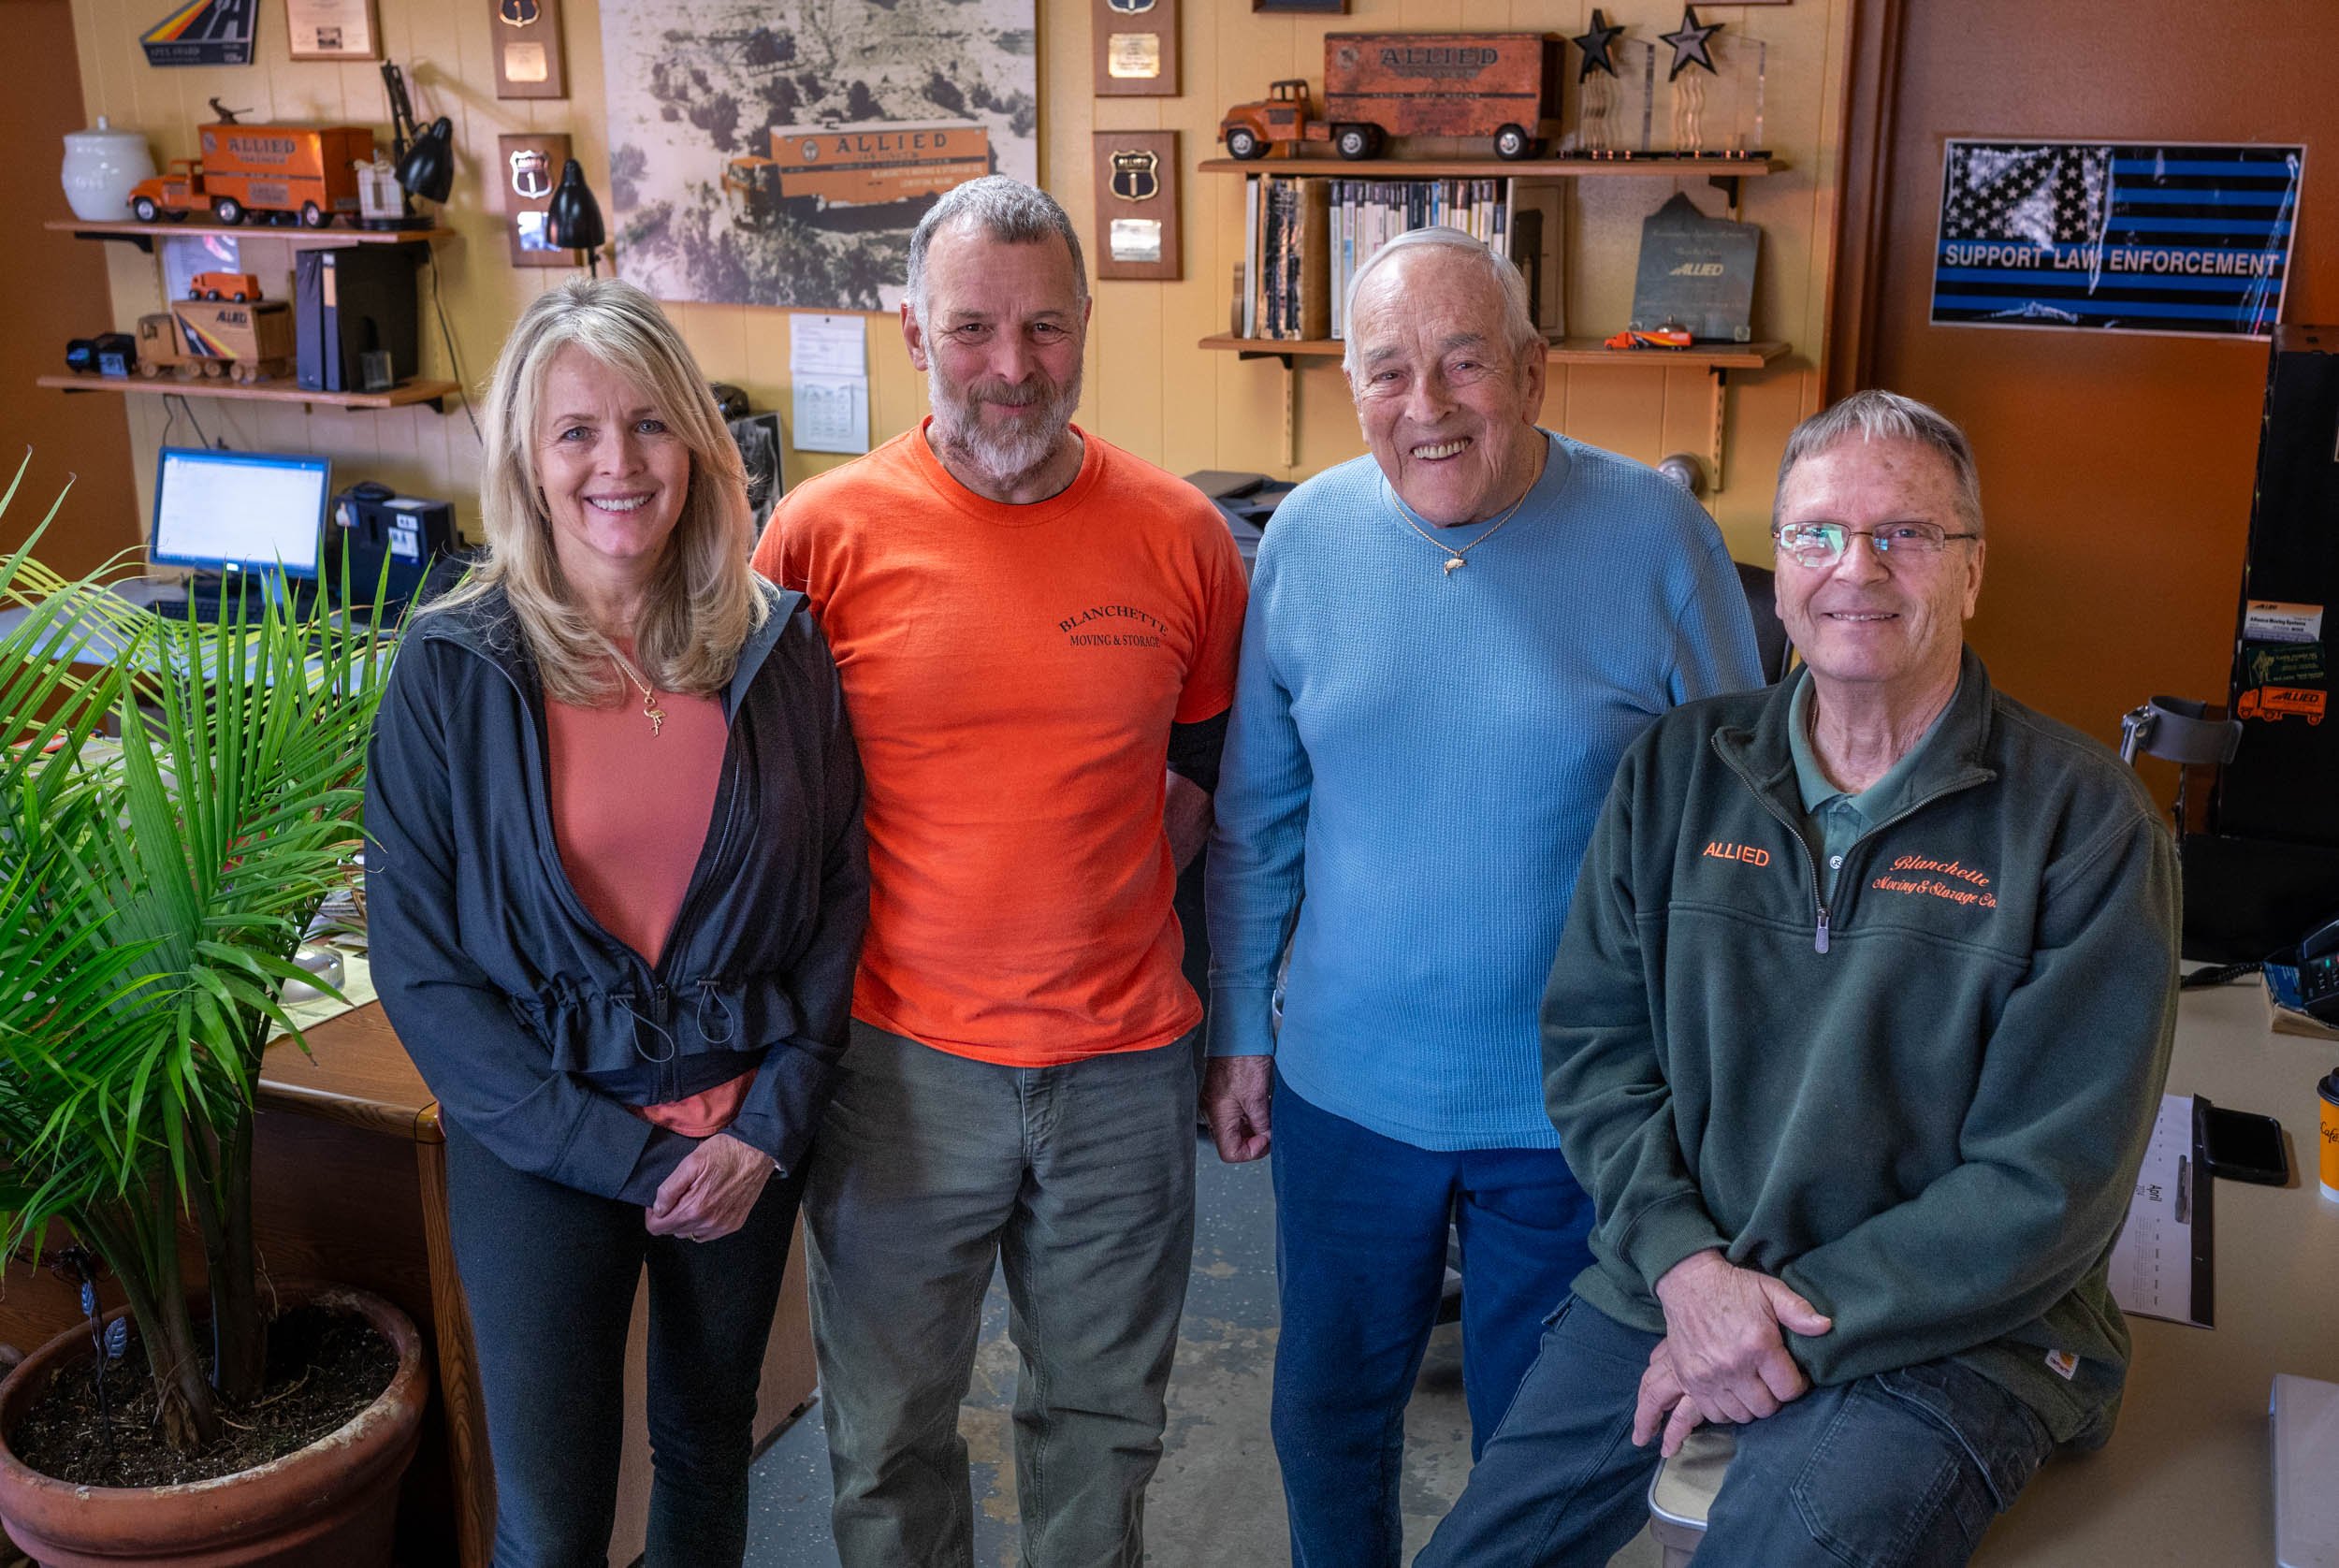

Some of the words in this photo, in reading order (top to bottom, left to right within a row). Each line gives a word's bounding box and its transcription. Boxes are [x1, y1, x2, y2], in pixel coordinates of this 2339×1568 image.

[1380, 47, 1499, 65] ALLIED
[228, 138, 297, 154] ALLIED
[835, 133, 948, 153] ALLIED
[1945, 244, 2043, 269] SUPPORT
[2054, 247, 2101, 270] LAW
[2109, 249, 2280, 276] ENFORCEMENT
[1669, 263, 1724, 277] ALLIED
[1058, 605, 1169, 636] BLANCHETTE
[1070, 634, 1111, 646] MOVING
[1113, 635, 1122, 646] &
[1123, 634, 1160, 648] STORAGE
[2272, 690, 2319, 704] ALLIED
[1702, 841, 1770, 867] ALLIED
[1890, 855, 1990, 887] Blanchette
[1872, 876, 1918, 894] Moving
[1916, 879, 1930, 893] &
[1929, 881, 1978, 905] Storage
[1979, 893, 1998, 907] Co.
[2146, 1183, 2162, 1202] April
